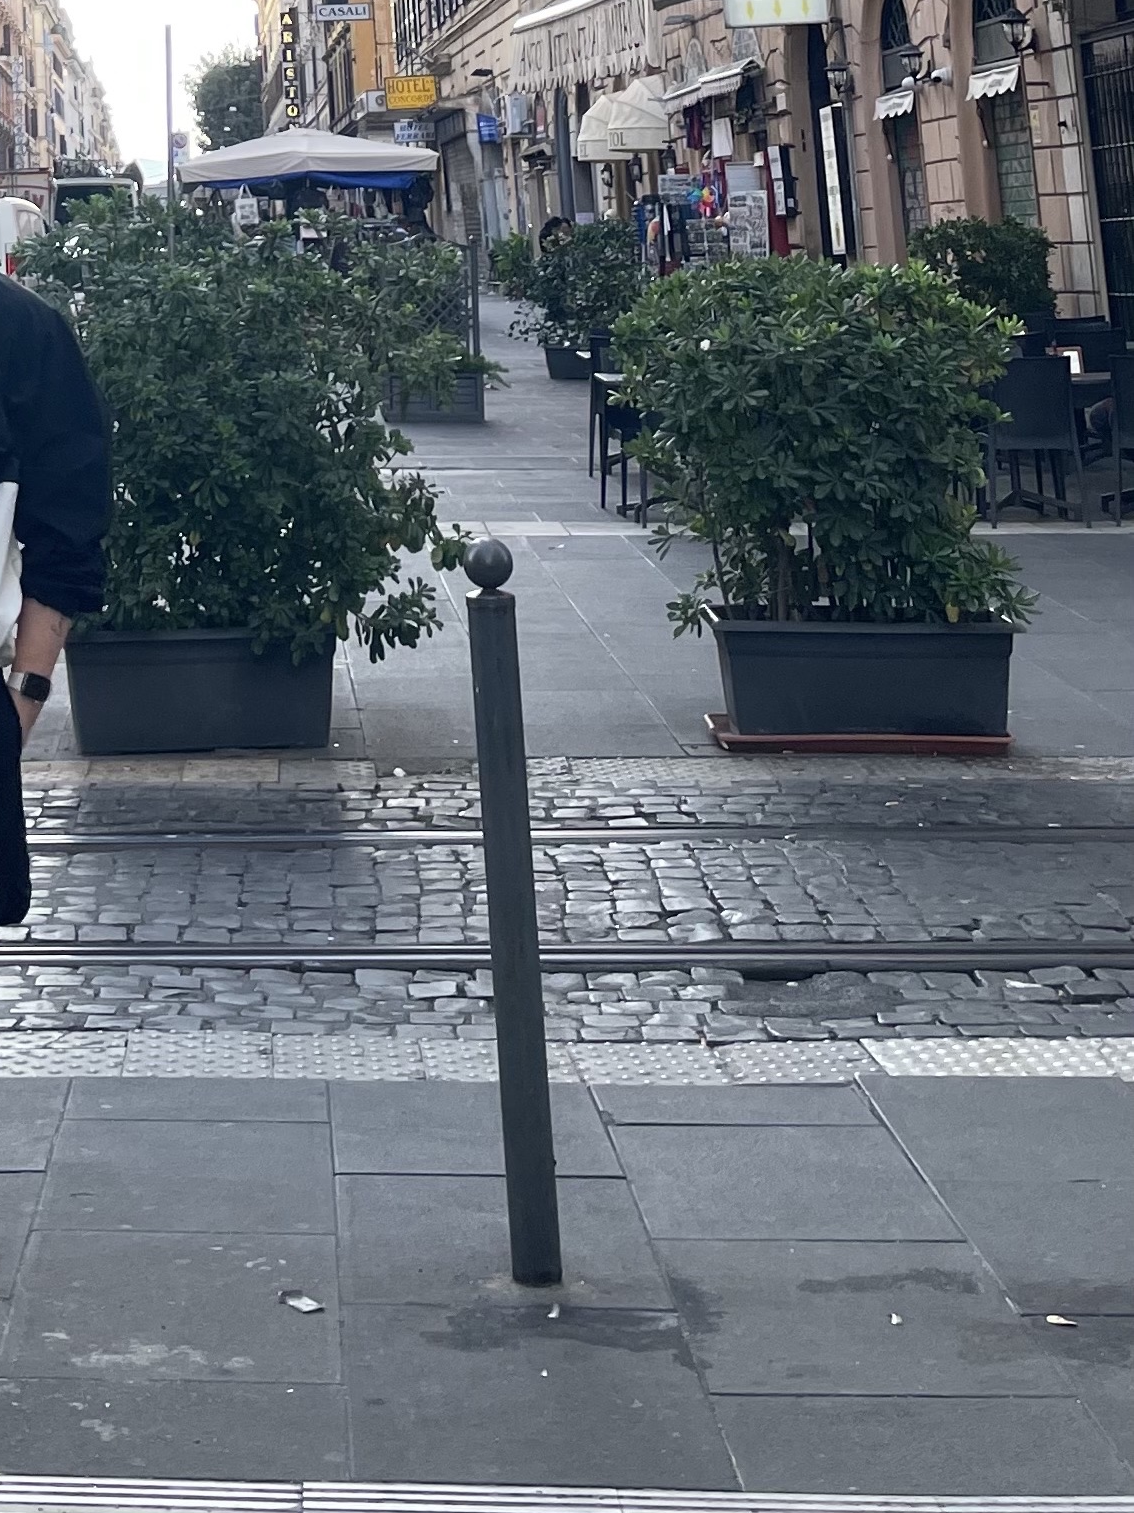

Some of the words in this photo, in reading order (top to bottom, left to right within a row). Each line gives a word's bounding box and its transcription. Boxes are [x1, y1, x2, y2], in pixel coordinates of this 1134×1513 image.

[318, 6, 367, 18] CASALI
[387, 78, 429, 94] HOTEL
[389, 94, 434, 104] CONCORDE
